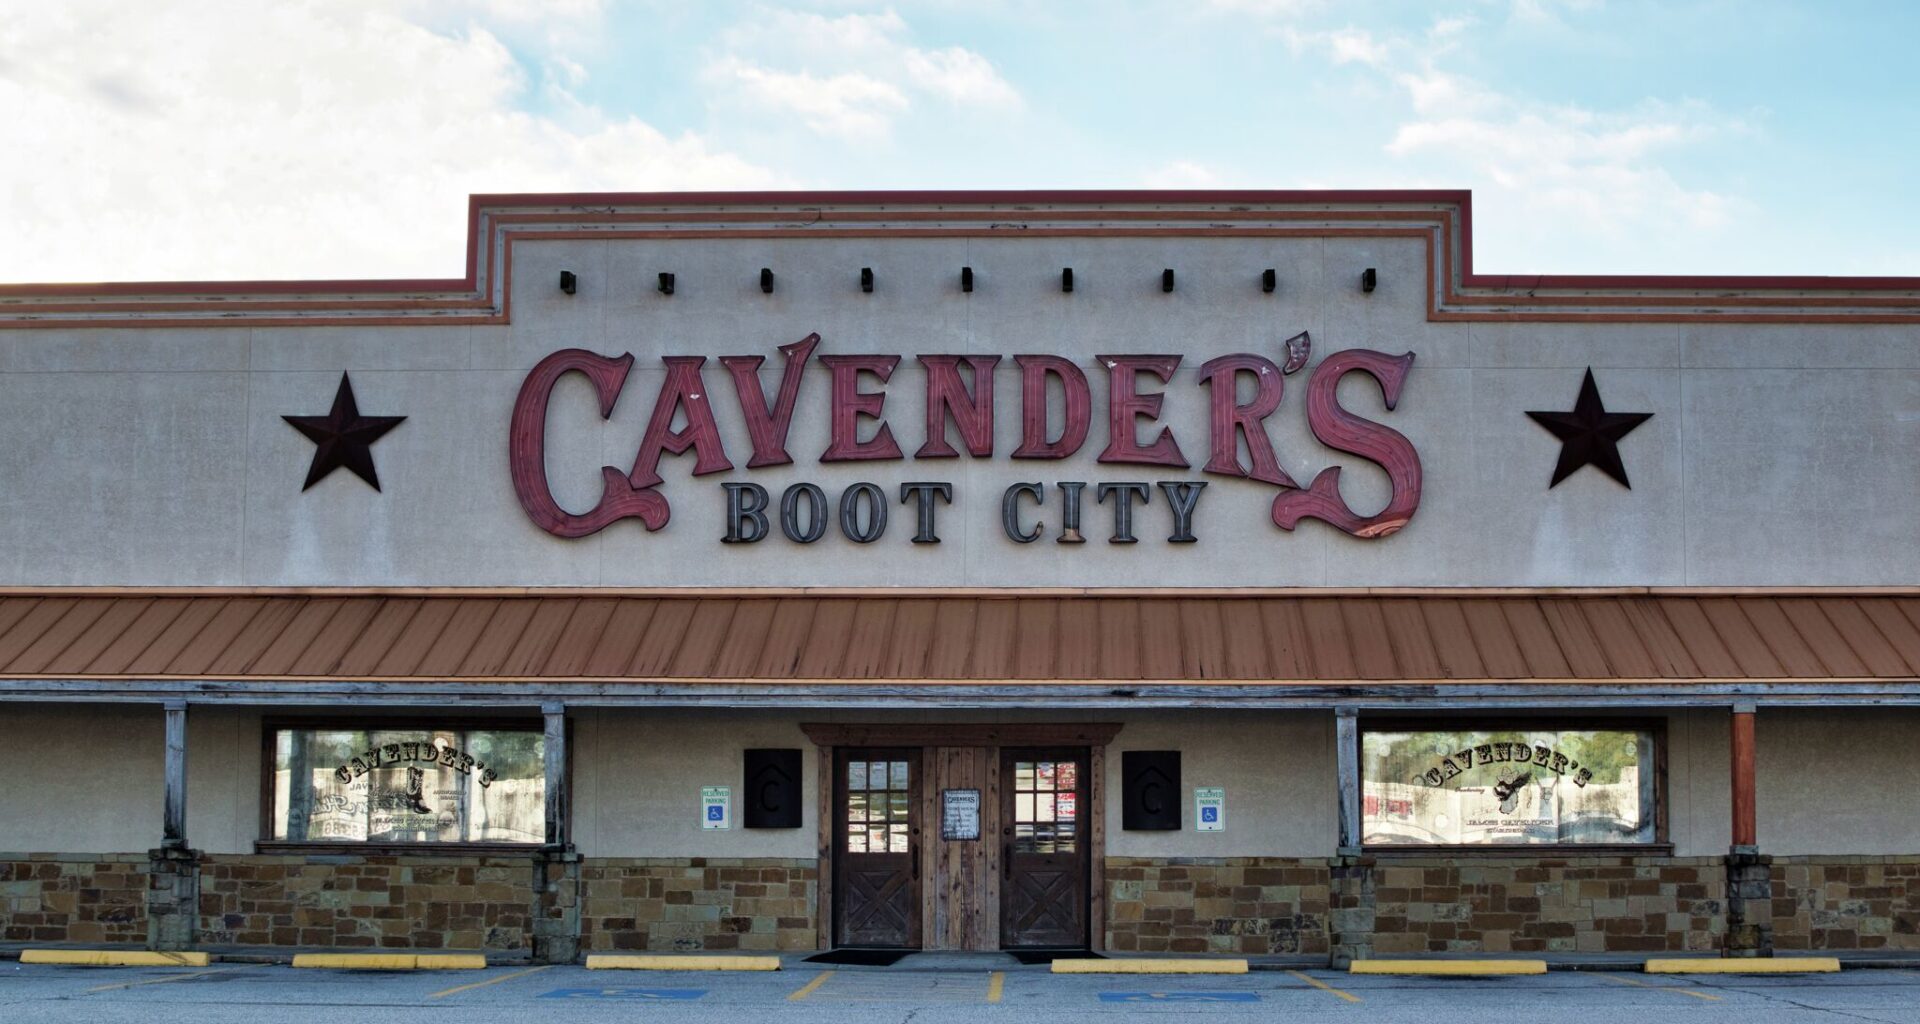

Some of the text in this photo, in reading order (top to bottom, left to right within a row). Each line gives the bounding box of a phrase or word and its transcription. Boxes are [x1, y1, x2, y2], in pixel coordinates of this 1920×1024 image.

[510, 330, 1422, 539] CAVENDER'S
[720, 481, 1208, 544] BOOT CITY
[334, 742, 498, 788] CAVENDER'S
[1426, 742, 1593, 788] CAVENDER'S
